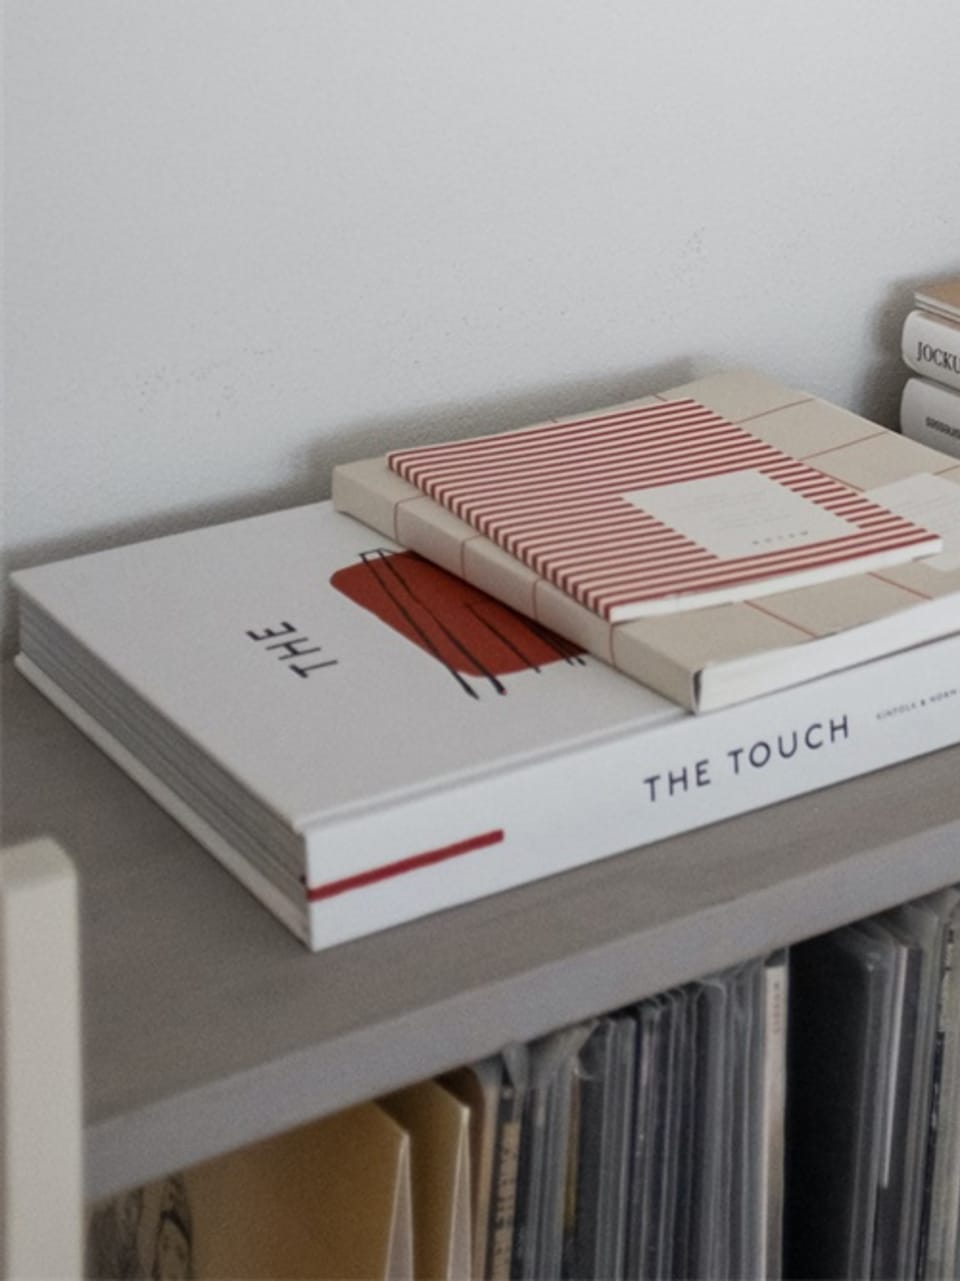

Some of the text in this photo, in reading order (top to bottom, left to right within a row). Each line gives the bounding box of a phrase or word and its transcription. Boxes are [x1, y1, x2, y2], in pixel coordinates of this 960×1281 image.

[245, 620, 339, 679] THE
[643, 713, 849, 803] THE TOUCH
